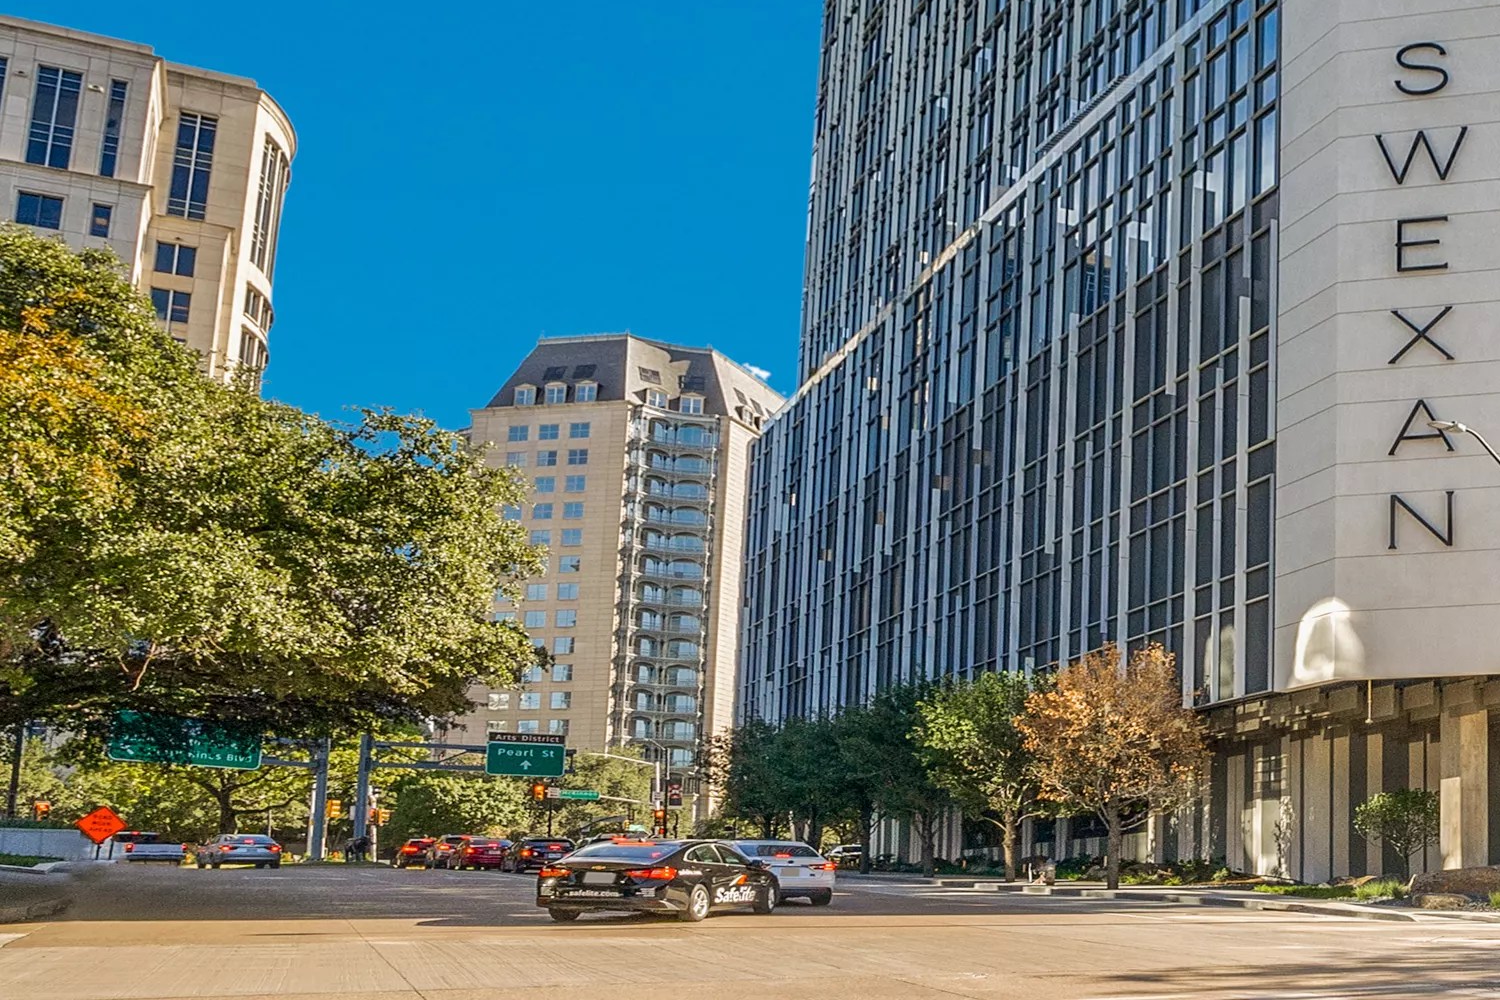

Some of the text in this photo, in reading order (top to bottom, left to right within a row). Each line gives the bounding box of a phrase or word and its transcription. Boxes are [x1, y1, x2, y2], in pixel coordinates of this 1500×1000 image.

[1375, 42, 1468, 549] SWEXAN
[521, 735, 560, 743] District
[497, 748, 555, 758] Pearl St
